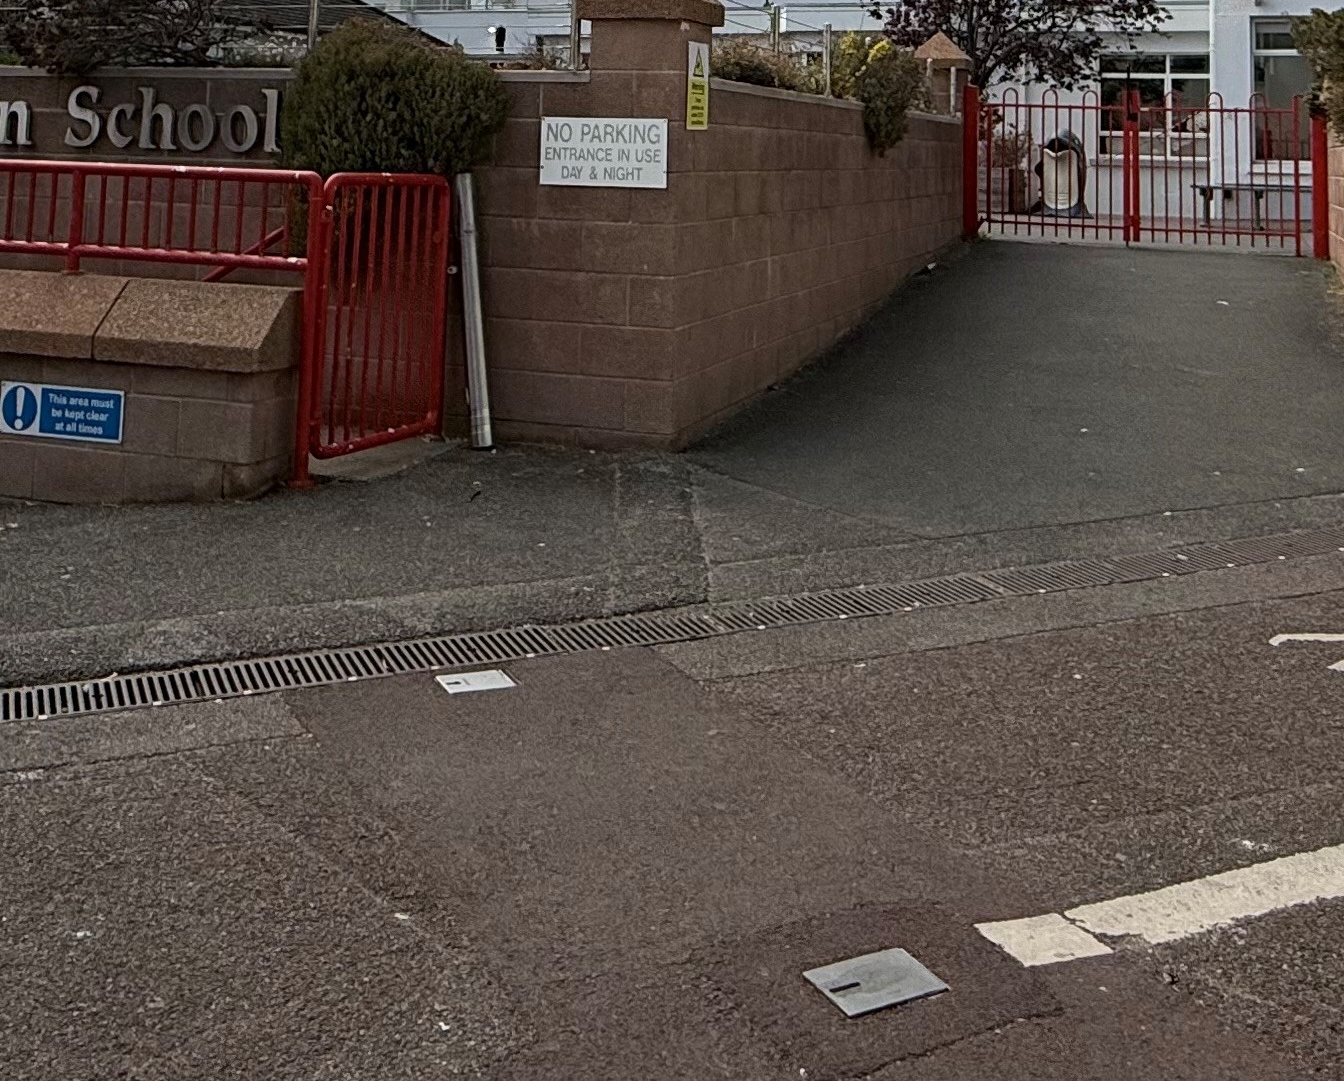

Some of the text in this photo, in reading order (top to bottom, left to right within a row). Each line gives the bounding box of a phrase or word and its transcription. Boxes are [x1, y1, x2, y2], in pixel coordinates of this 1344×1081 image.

[64, 85, 282, 153] School
[546, 123, 661, 144] NO PARKING
[544, 147, 661, 163] ENTRANCE IN USE
[561, 165, 643, 181] DAY & NIGHT
[48, 393, 114, 409] This area must
[51, 408, 109, 421] be kept clear
[55, 422, 103, 434] at all times
